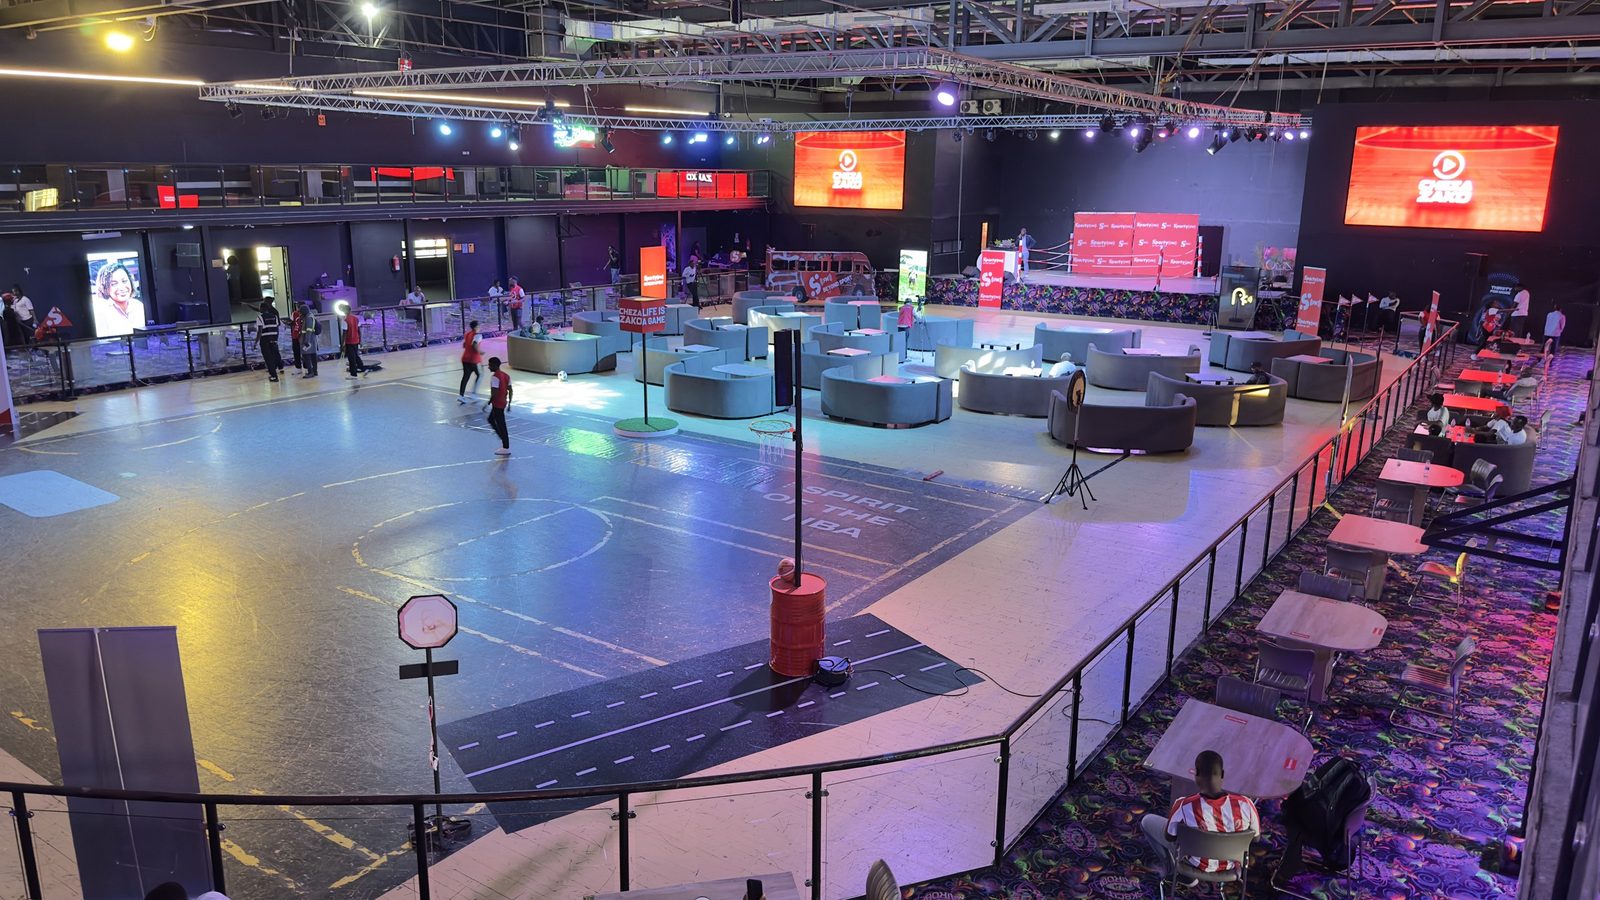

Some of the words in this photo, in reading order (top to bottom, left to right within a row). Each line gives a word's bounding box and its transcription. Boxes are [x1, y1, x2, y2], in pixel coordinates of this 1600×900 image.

[619, 308, 642, 317] CHEZA
[642, 307, 658, 317] LIFE
[658, 306, 666, 315] IS
[620, 316, 642, 326] ZAKO
[648, 316, 666, 325] GAME
[803, 485, 919, 513] SPIRIT
[763, 493, 815, 505] OF
[822, 504, 896, 526] THE
[781, 514, 863, 539] NBA
